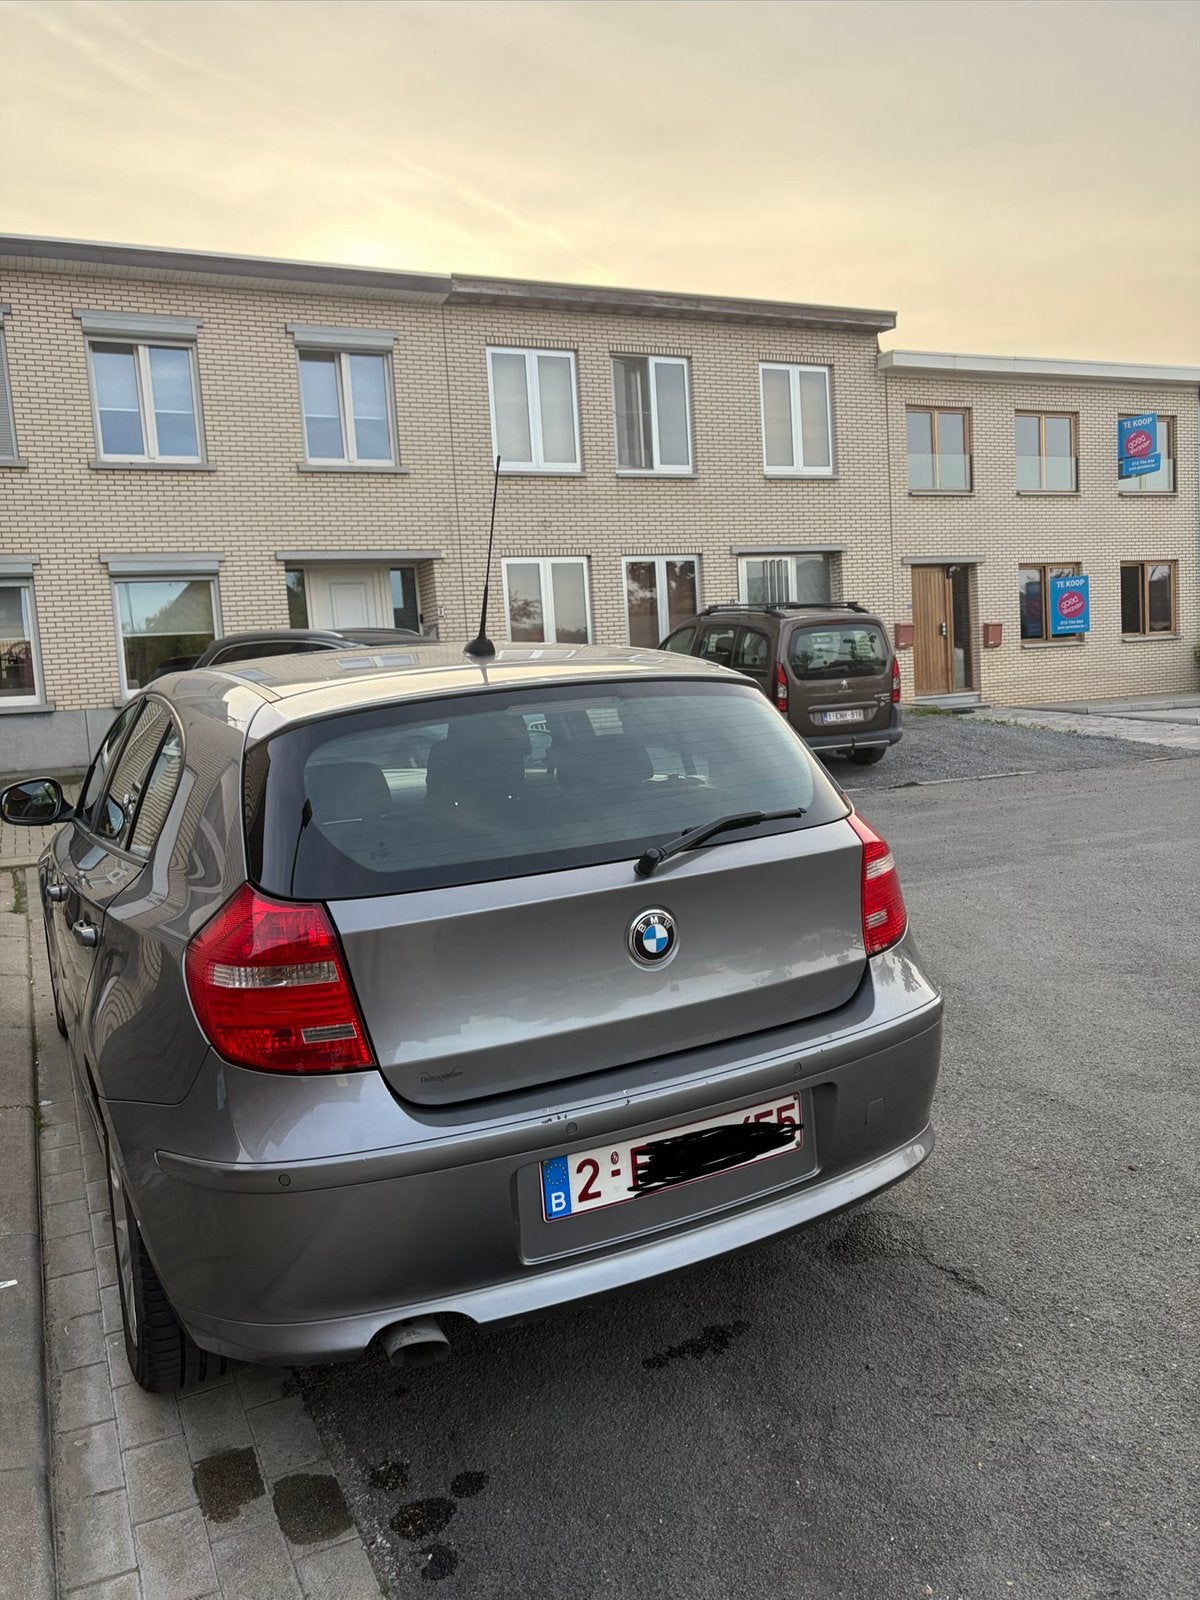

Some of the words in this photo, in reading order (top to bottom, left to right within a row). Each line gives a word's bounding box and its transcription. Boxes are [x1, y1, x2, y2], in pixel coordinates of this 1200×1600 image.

[1123, 420, 1132, 429] TE
[1133, 417, 1153, 427] KOOP
[1056, 580, 1065, 588] TE
[1066, 578, 1085, 587] KOOP
[638, 915, 673, 933] BMW
[551, 1191, 567, 1213] B
